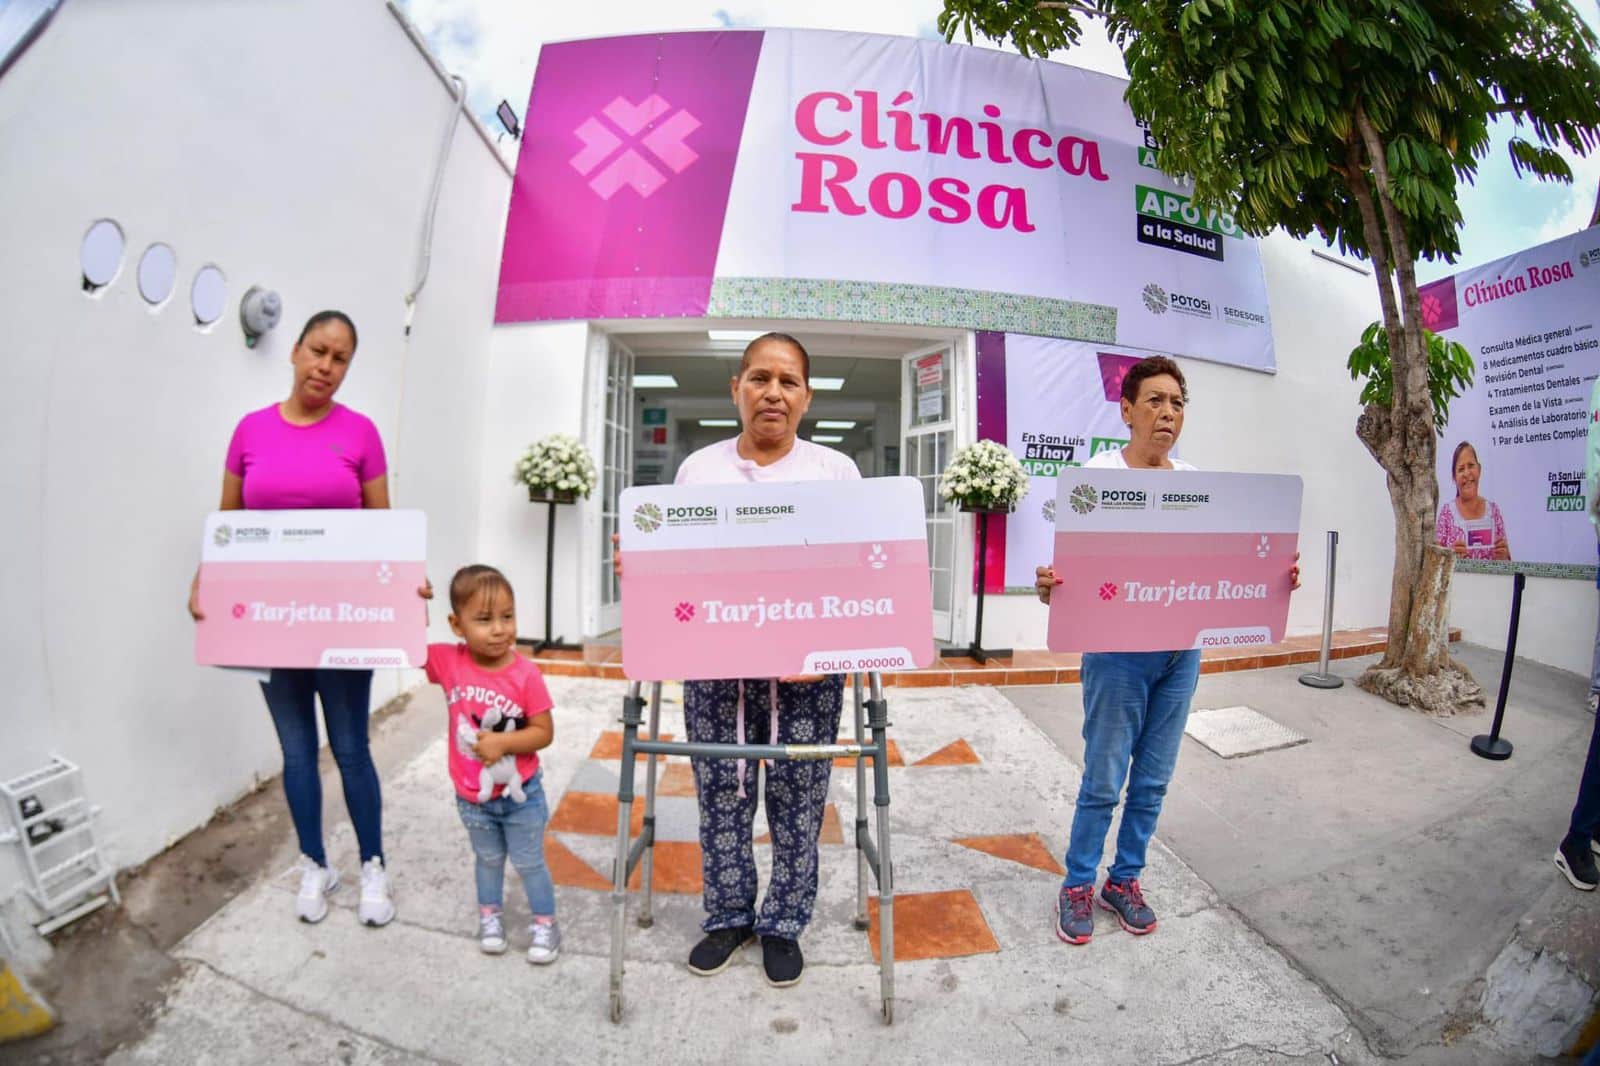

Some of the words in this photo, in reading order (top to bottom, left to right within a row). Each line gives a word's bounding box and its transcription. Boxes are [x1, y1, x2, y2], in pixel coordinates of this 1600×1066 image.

[795, 90, 1109, 181] Clínica
[791, 151, 1036, 232] Rosa
[1143, 223, 1154, 236] a
[1157, 223, 1172, 240] la
[1174, 229, 1217, 252] Salud
[1464, 275, 1527, 308] Clínica
[1526, 260, 1575, 289] Rosa
[1223, 307, 1265, 323] SEDESORE
[1480, 340, 1514, 355] Consulta
[1515, 334, 1543, 346] Médica
[1543, 325, 1573, 343] general
[1489, 350, 1545, 369] Medicamentos
[1546, 343, 1573, 357] cuadro
[1485, 369, 1518, 384] Revisión
[1518, 364, 1544, 378] Dental
[1488, 390, 1493, 399] 4
[1494, 382, 1545, 398] Tratamientos
[1547, 375, 1581, 389] Dentales
[1489, 404, 1521, 416] Examen
[1522, 401, 1532, 411] de
[1533, 399, 1541, 409] la
[1542, 397, 1563, 408] Vista
[1498, 416, 1529, 429] Análisis
[1529, 414, 1540, 425] de
[1541, 409, 1588, 424] Laboratorio
[1021, 432, 1036, 443] En
[1038, 434, 1060, 446] San
[1063, 436, 1086, 447] Luis
[1499, 435, 1512, 445] Par
[1513, 433, 1524, 444] de
[1525, 431, 1552, 443] Lentes
[1042, 446, 1071, 461] hay
[1548, 472, 1557, 481] En
[1558, 471, 1572, 481] San
[1161, 494, 1210, 503] SEDESORE
[1561, 482, 1579, 497] hay
[735, 505, 795, 516] SEDESORE
[1548, 498, 1583, 511] APOYO
[1124, 579, 1211, 607] Tarjeta
[1215, 579, 1268, 600] Rosa
[251, 601, 332, 628] Tarjeta
[337, 601, 396, 622] Rosa
[702, 597, 815, 627] Tarjeta
[820, 596, 895, 619] Rosa
[1233, 634, 1266, 644] 000000
[814, 659, 855, 672] FOLIO.
[858, 656, 905, 670] 000000
